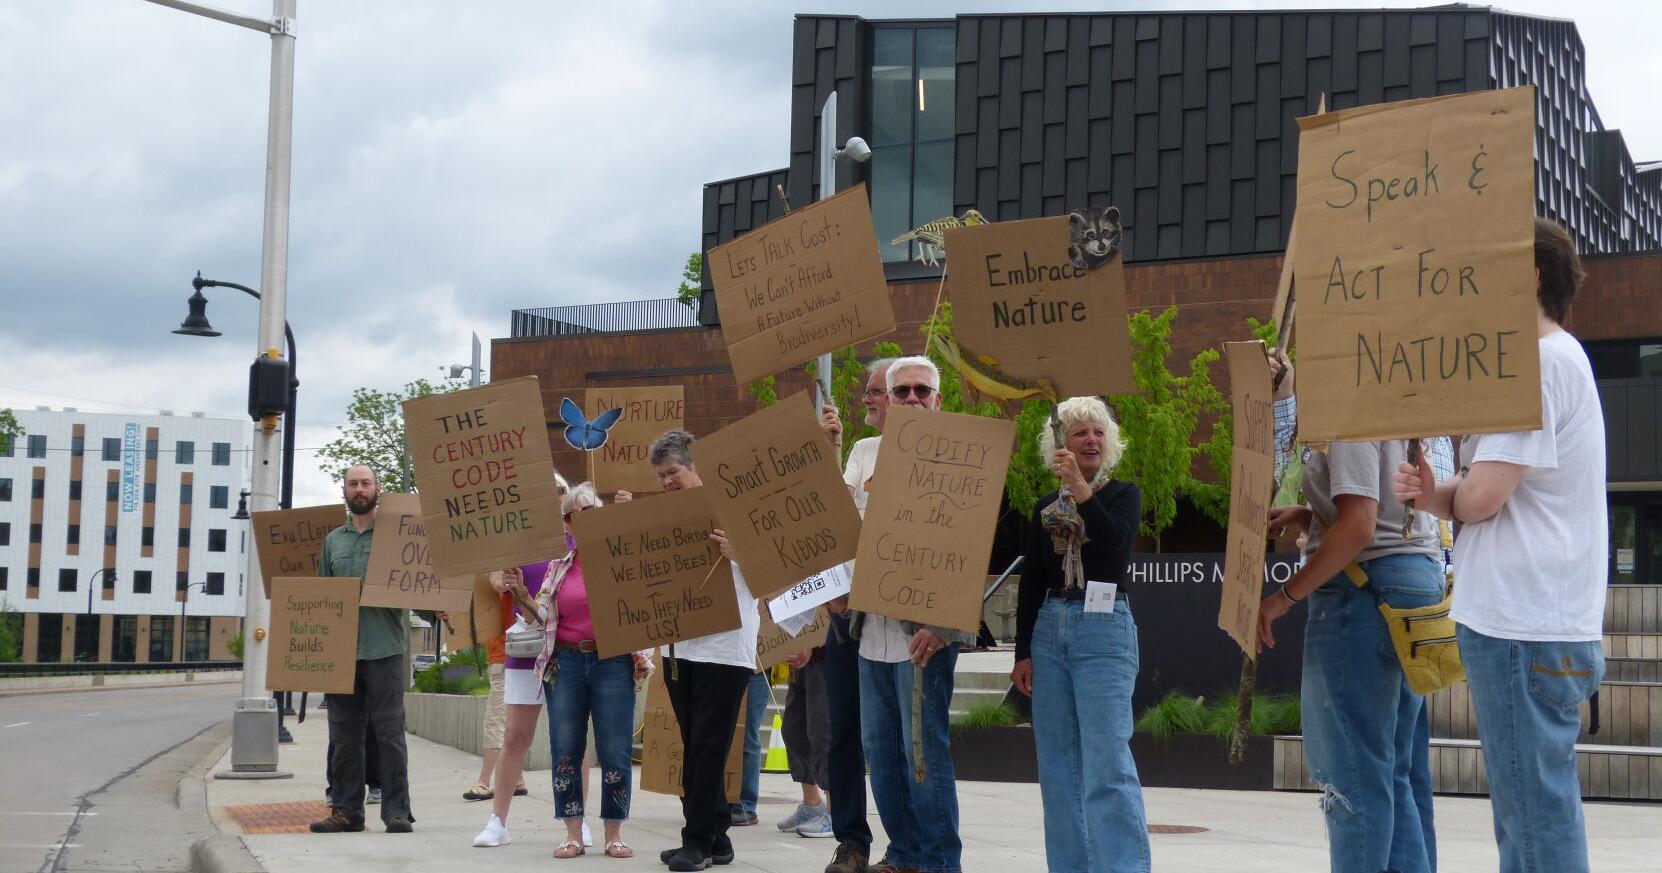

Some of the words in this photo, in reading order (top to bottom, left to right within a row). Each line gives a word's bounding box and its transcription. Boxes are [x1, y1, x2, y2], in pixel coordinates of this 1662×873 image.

[1326, 150, 1440, 223] Speak
[1468, 143, 1488, 195] &
[759, 233, 795, 265] TALK
[986, 251, 1087, 287] Embrace
[1324, 255, 1384, 305] ACT
[1417, 248, 1480, 298] FOR
[744, 286, 764, 311] We
[992, 297, 1086, 328] Nature
[757, 314, 766, 332] A
[1356, 330, 1519, 387] NATURE
[435, 408, 488, 434] THE
[597, 391, 684, 422] NURTURE
[433, 426, 526, 464] CENTURY
[603, 441, 648, 465] NATU
[898, 420, 992, 464] CODIFY
[452, 458, 518, 489] CODE
[909, 463, 987, 497] NATURE
[123, 483, 133, 510] NOW
[445, 485, 521, 519] NEEDS
[450, 509, 533, 543] NATURE
[748, 509, 781, 535] FOR
[785, 491, 827, 522] OUR
[894, 504, 913, 522] in
[927, 500, 954, 529] the
[606, 536, 632, 558] WE
[876, 532, 968, 572] CENTURY
[386, 569, 441, 594] FORM
[611, 565, 637, 585] WE
[878, 570, 937, 609] CODE
[286, 594, 343, 617] Supporting
[617, 600, 650, 627] AND
[290, 620, 329, 636] Nature
[646, 619, 681, 641] US!
[756, 611, 832, 656] Biodiersity
[289, 639, 323, 653] Builds
